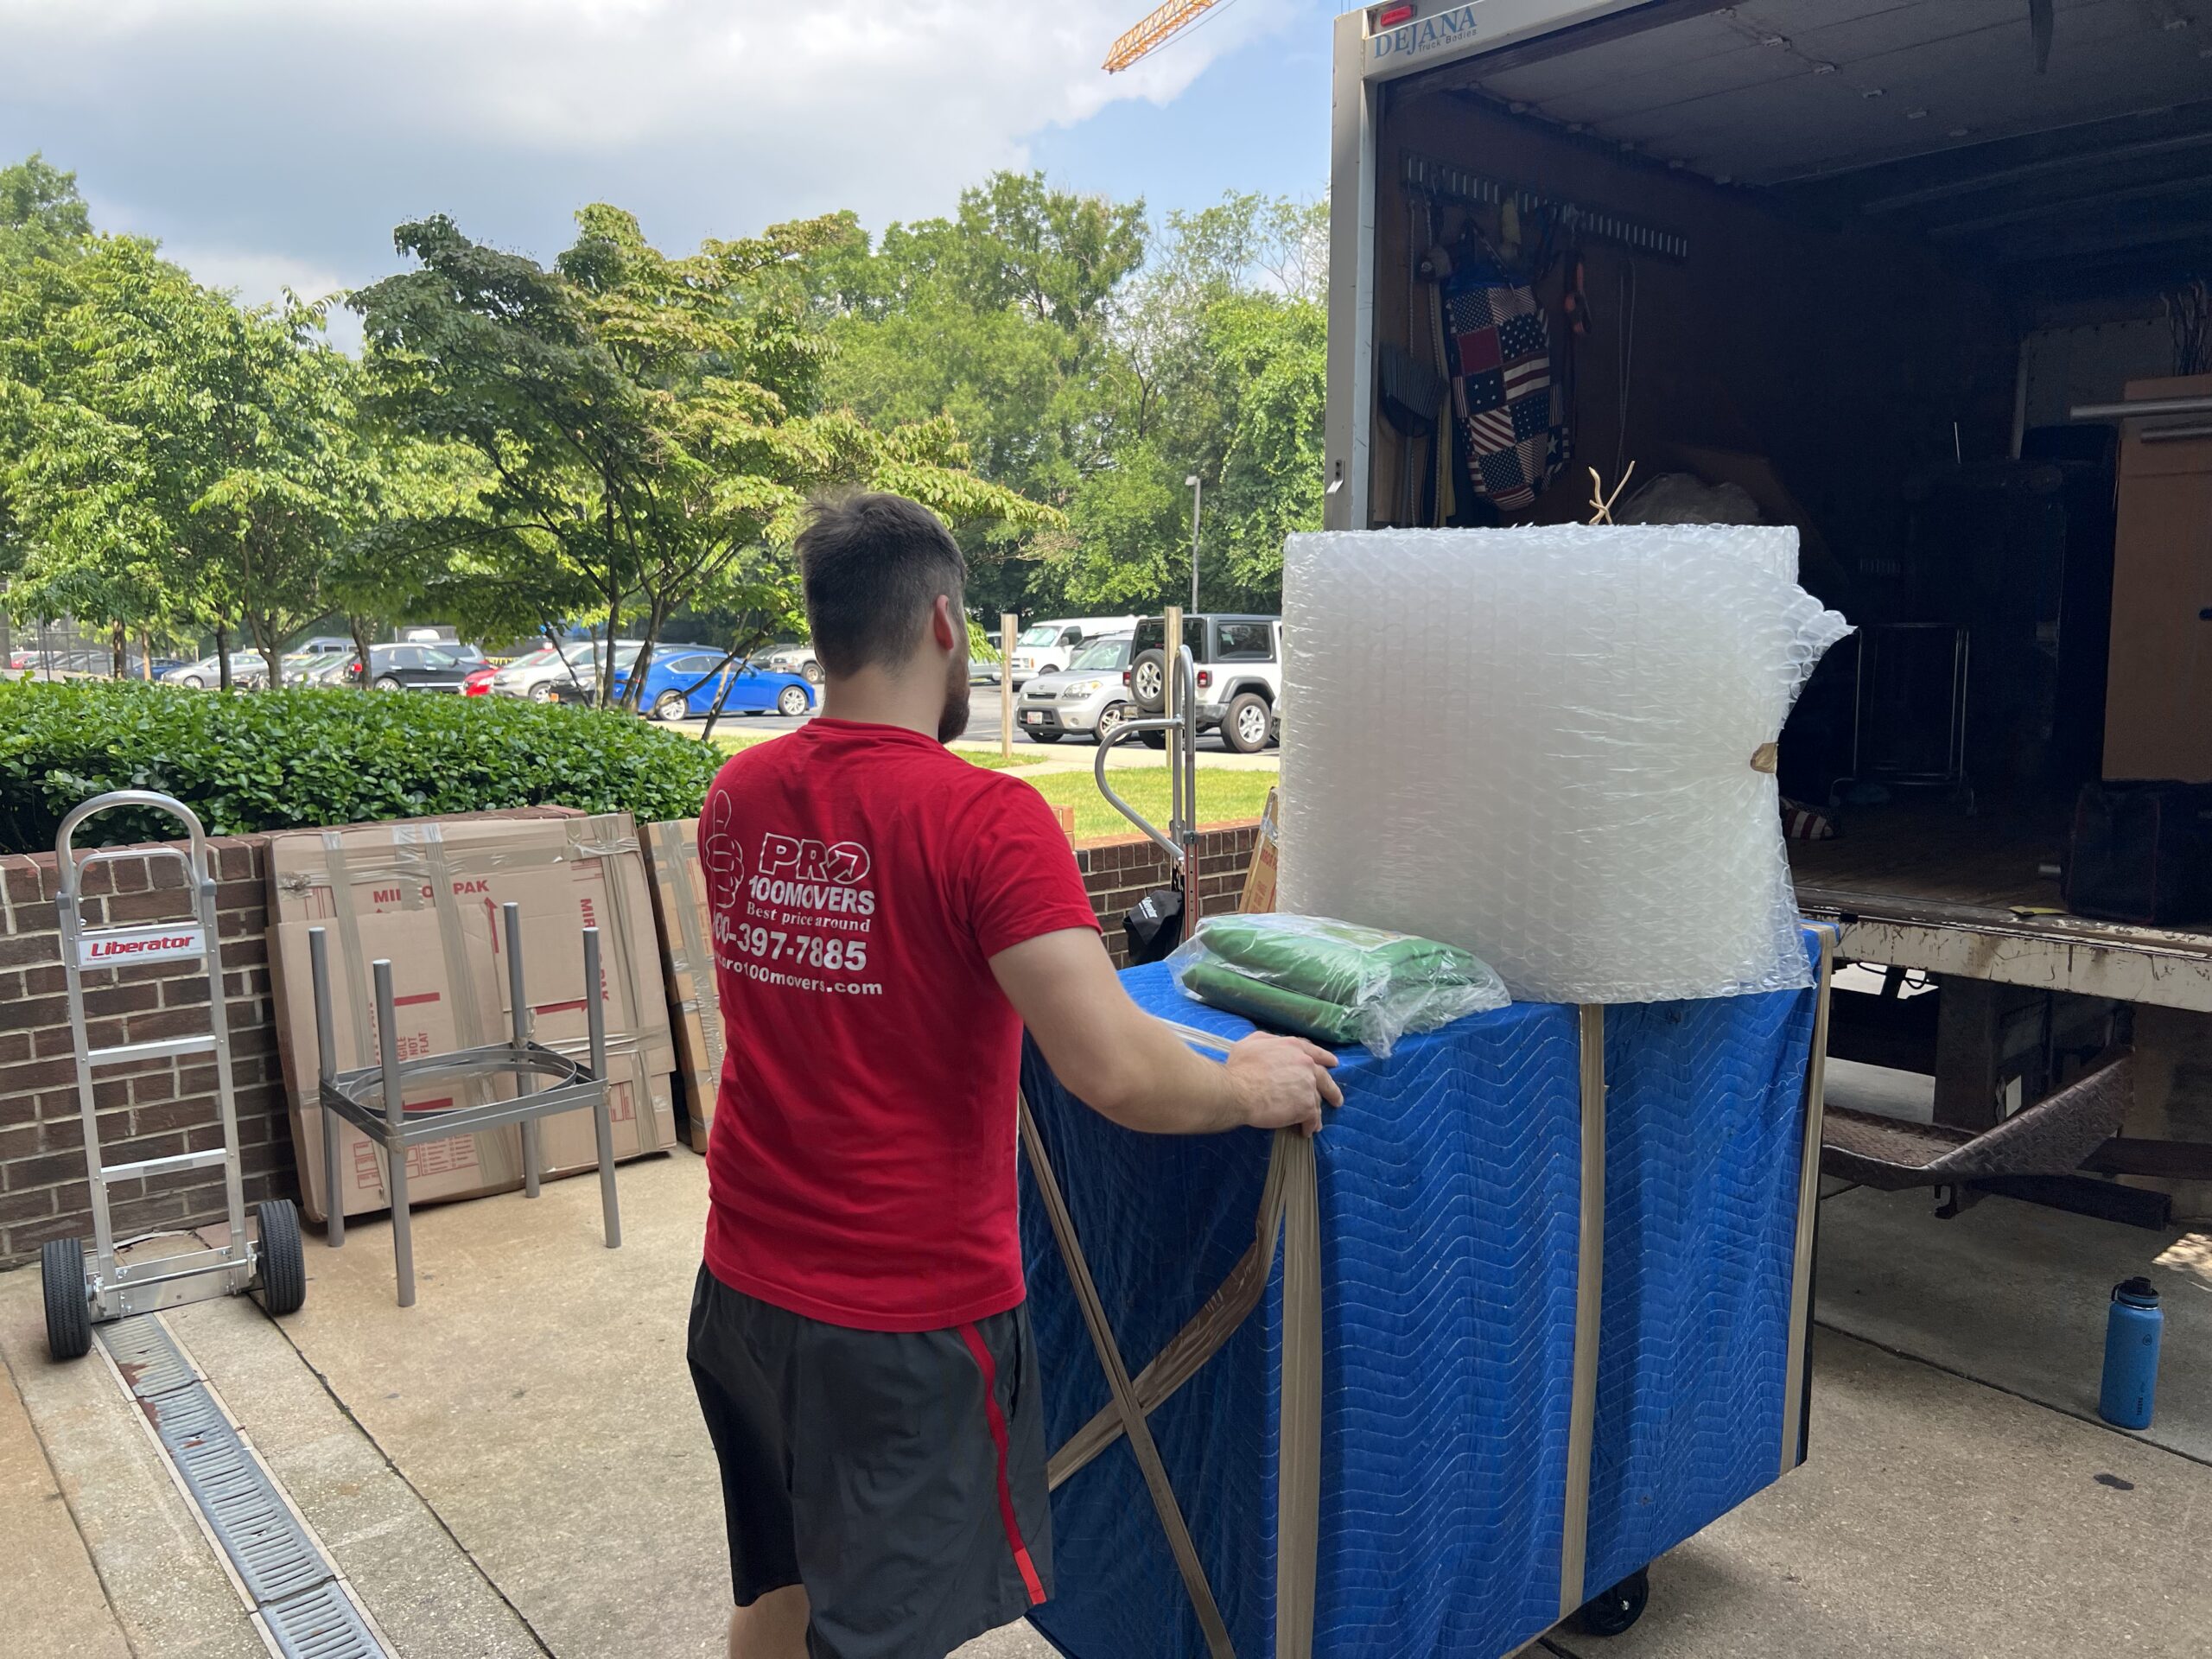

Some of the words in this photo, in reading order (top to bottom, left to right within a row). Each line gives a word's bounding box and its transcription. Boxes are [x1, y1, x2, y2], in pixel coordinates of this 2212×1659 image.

[1374, 5, 1478, 59] DEJANA
[1418, 41, 1441, 53] Truck
[1446, 29, 1478, 44] Bodies
[453, 880, 490, 895] PAK
[748, 874, 875, 915] 100MOVERS
[747, 901, 777, 920] Best
[781, 912, 813, 925] price
[815, 918, 871, 932] around
[91, 936, 195, 957] Liberator
[407, 1037, 419, 1056] NOT
[418, 1031, 430, 1054] FLAT
